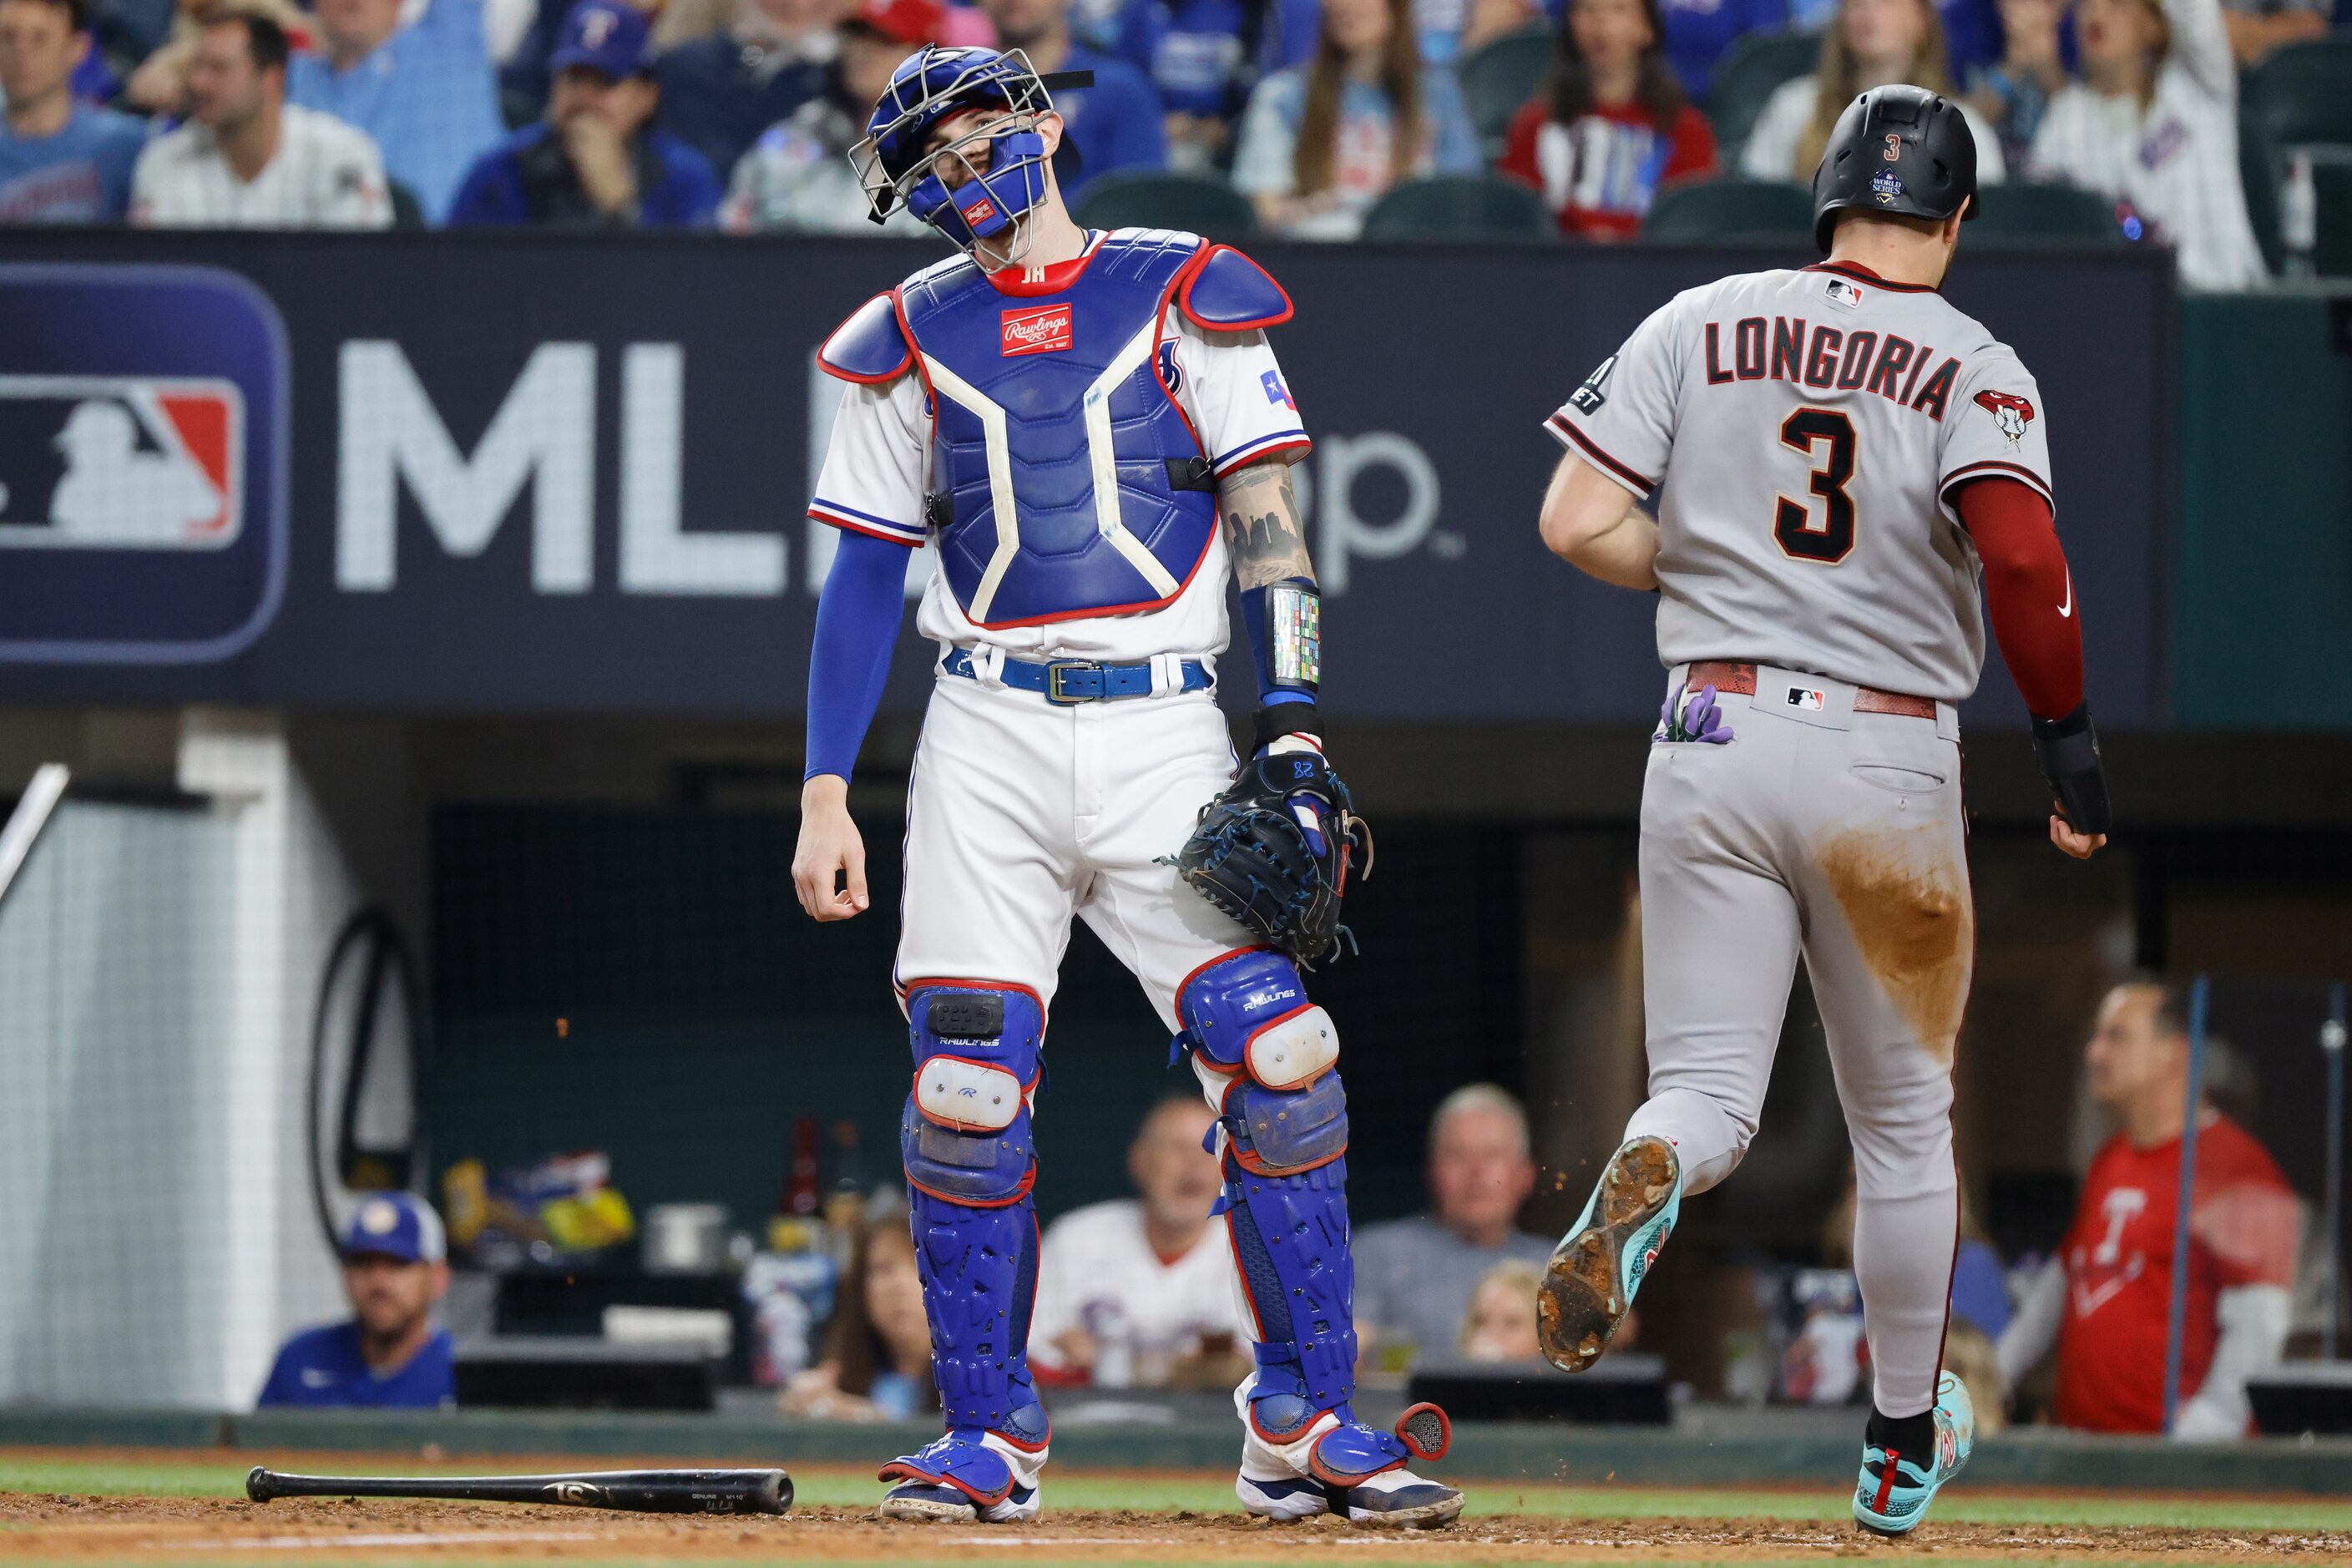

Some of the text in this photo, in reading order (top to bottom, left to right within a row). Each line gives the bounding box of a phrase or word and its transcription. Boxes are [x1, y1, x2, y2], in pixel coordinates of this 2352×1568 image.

[1884, 134, 1901, 161] 3
[1873, 185, 1900, 194] SERIES
[1874, 178, 1901, 188] WORLD
[1004, 316, 1069, 341] Rawlings
[1705, 316, 1962, 422] LONGORIA
[1770, 404, 1860, 567] 3
[1242, 989, 1296, 1012] RAWLINGS
[939, 1036, 1000, 1047] RAWLINGS
[2100, 1186, 2148, 1266] T
